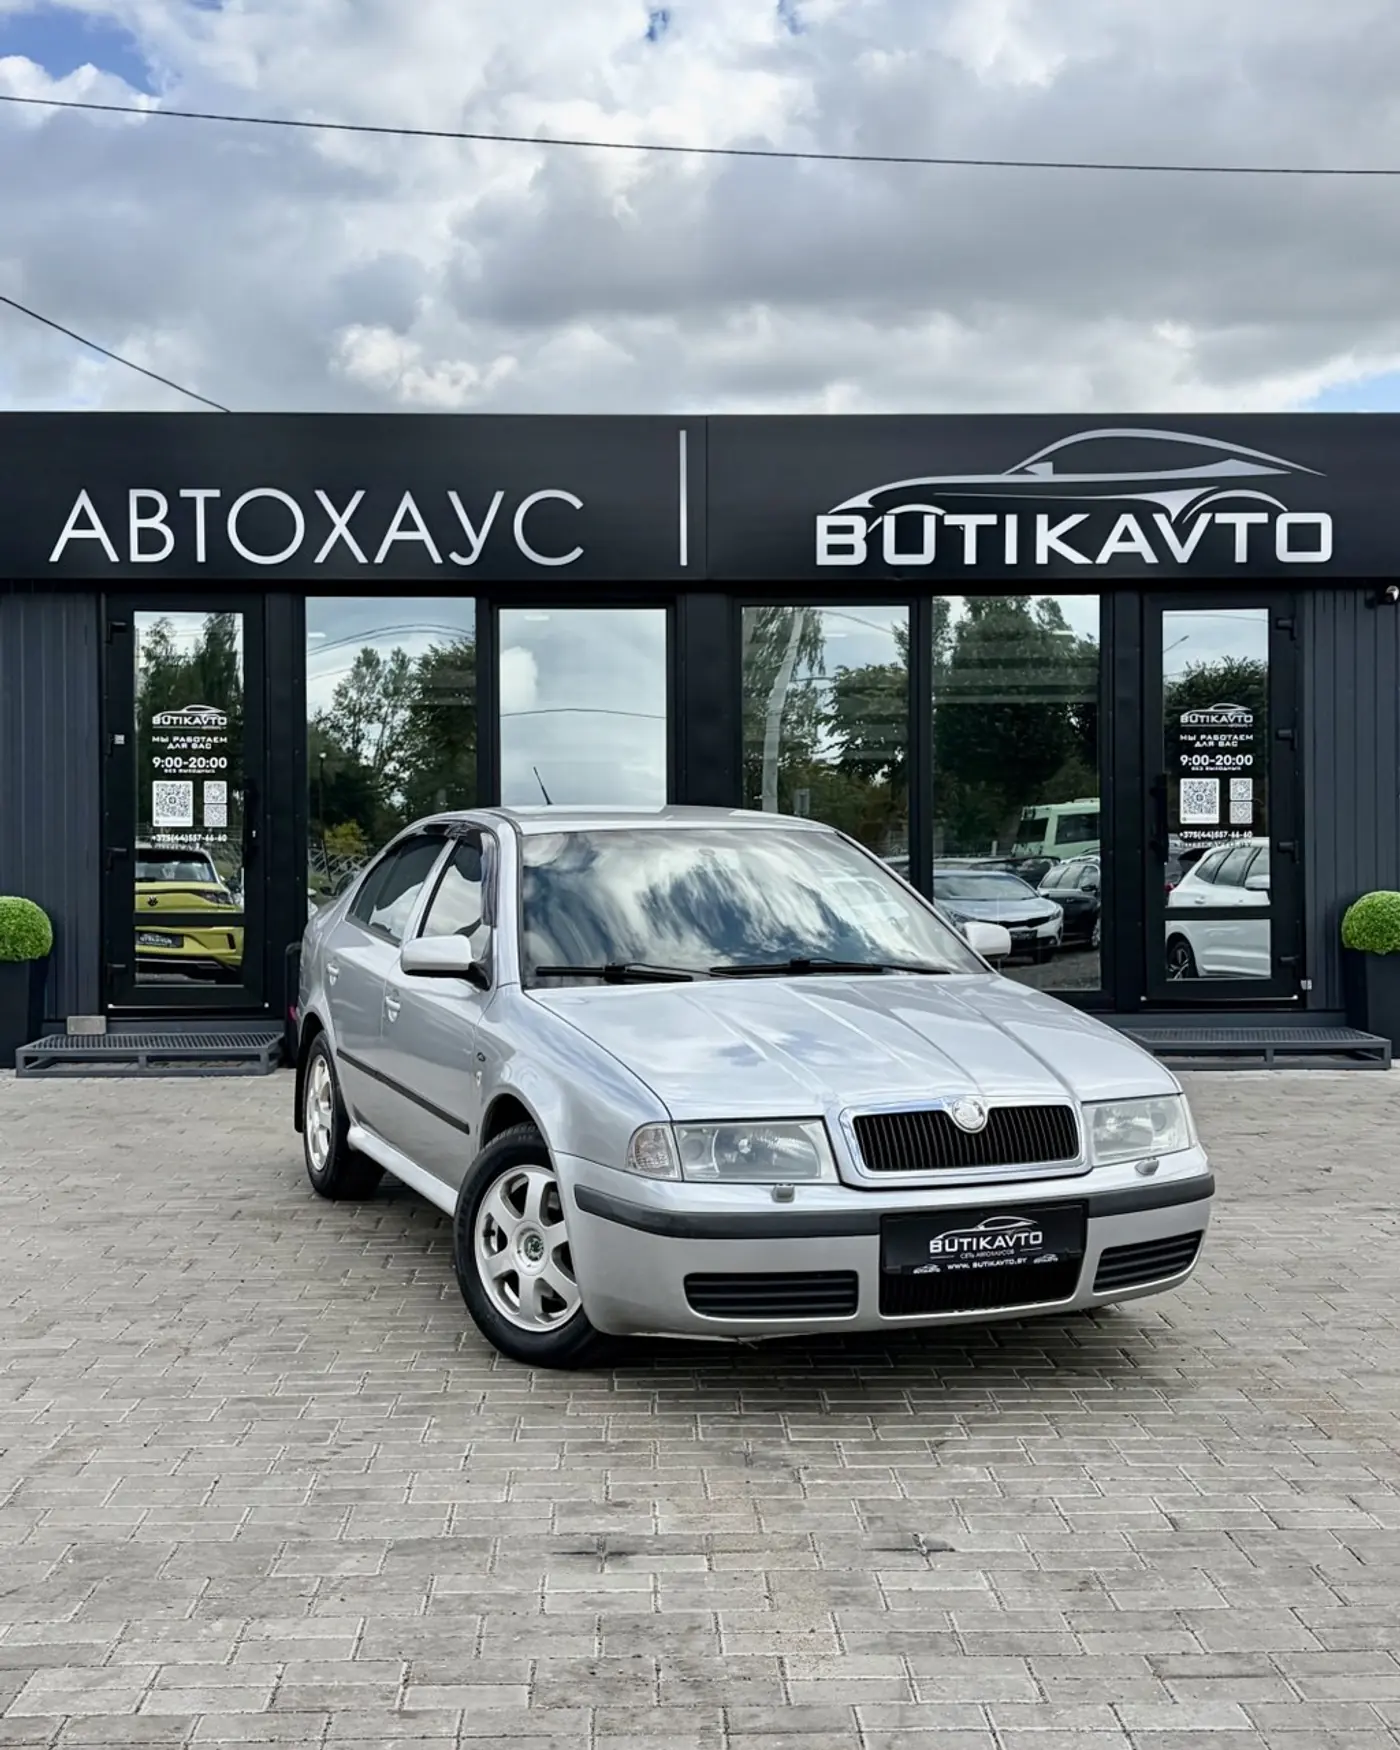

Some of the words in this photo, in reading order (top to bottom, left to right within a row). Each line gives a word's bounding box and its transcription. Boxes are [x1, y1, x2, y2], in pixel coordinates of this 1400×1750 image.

[49, 487, 584, 567] АВТОХАУС
[816, 512, 1333, 566] BUTIKAVTO
[152, 716, 227, 725] BUTIKAVTO
[1180, 714, 1253, 723] BUTIKAVTO
[152, 756, 228, 768] 9:00-20:00
[1180, 754, 1253, 766] 9:00-20:00
[929, 1231, 1043, 1254] BUTIKAVTO
